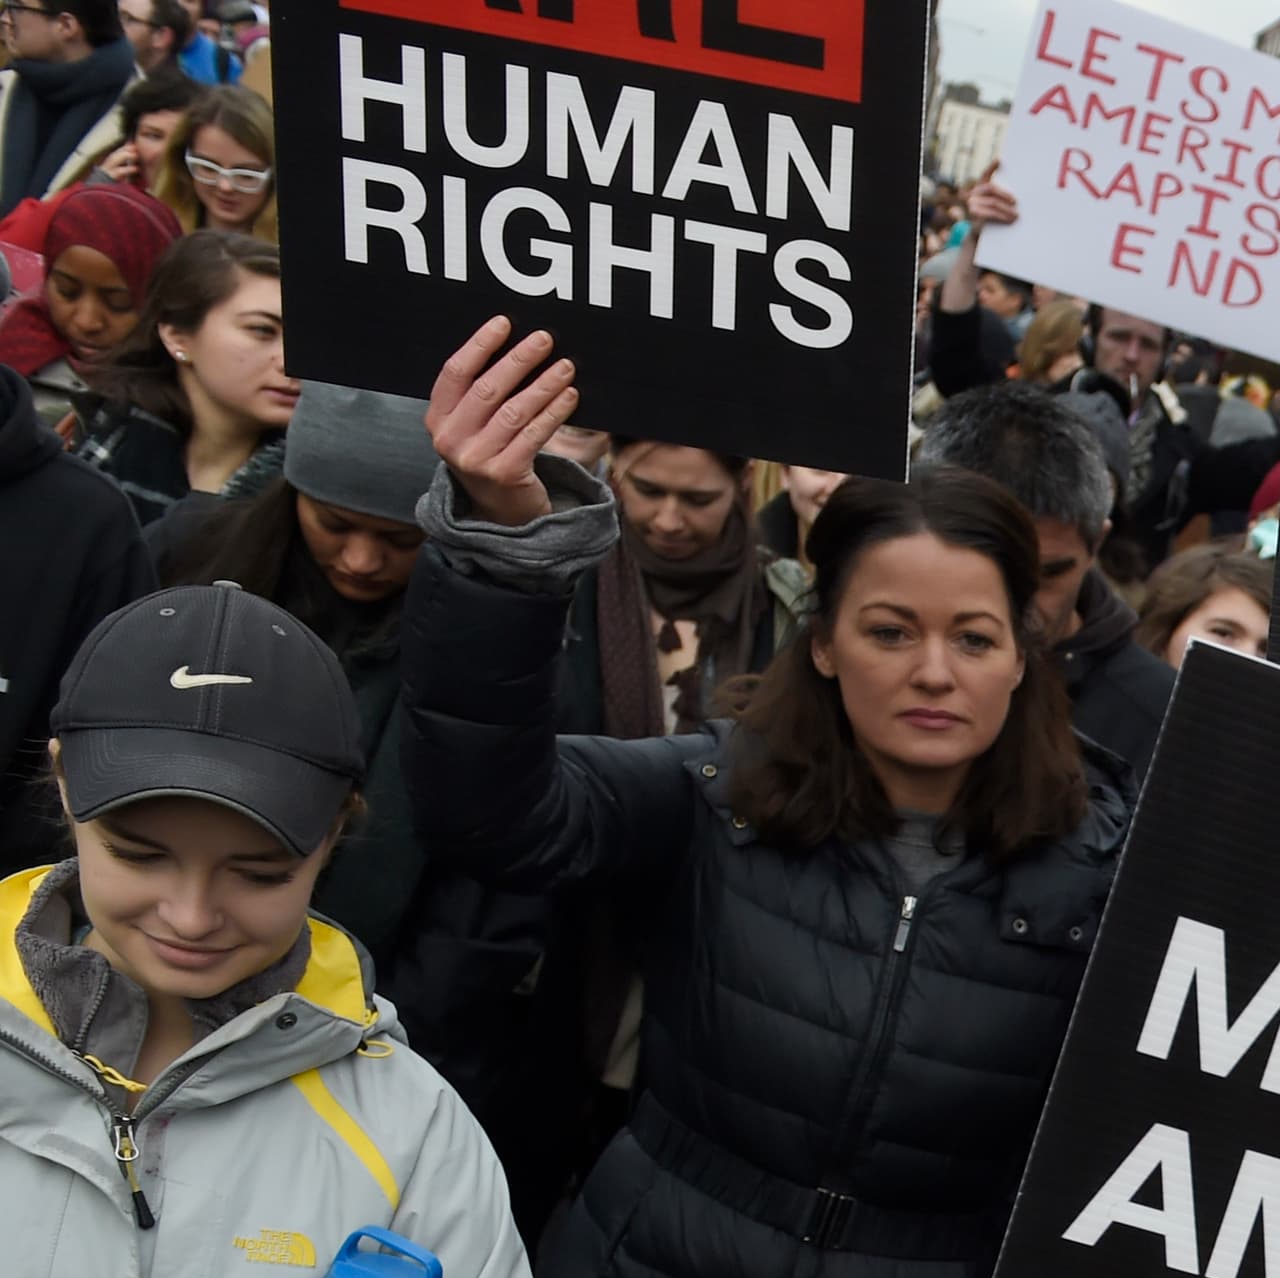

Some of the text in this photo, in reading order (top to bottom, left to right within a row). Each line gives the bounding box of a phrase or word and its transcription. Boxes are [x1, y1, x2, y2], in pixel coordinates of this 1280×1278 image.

[339, 33, 854, 232] HUMAN
[1036, 10, 1230, 124] LETS
[342, 157, 853, 349] RIGHTS
[1109, 222, 1265, 308] END
